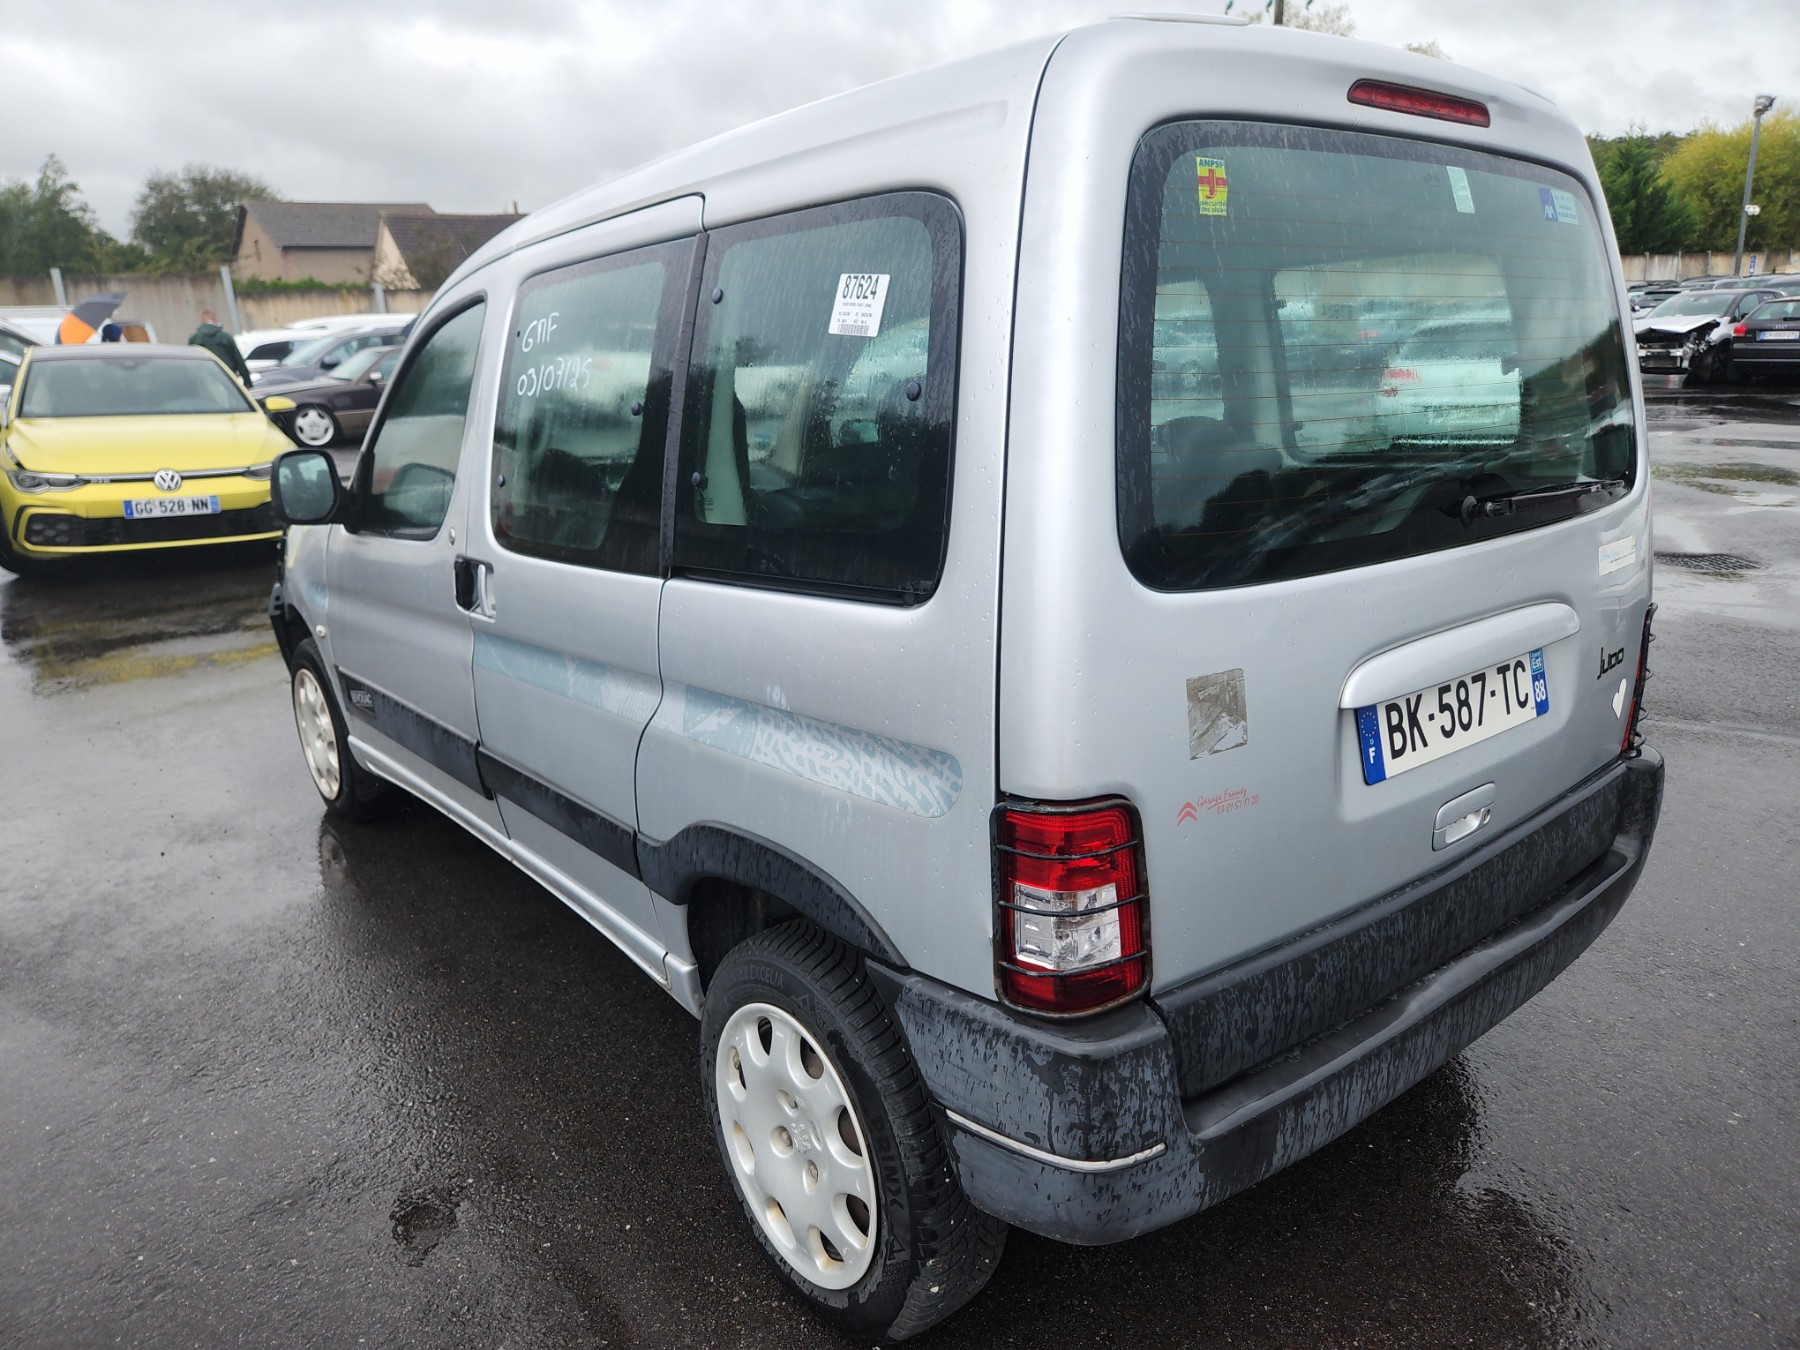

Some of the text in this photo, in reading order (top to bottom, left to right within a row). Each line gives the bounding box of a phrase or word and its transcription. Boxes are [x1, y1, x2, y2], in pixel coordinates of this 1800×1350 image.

[1199, 159, 1224, 168] ANPSP
[842, 274, 880, 300] 87624
[517, 356, 593, 398] 03/07/25
[1534, 679, 1546, 702] 88
[1385, 660, 1529, 760] BK-587-TC
[1368, 746, 1377, 764] F
[1197, 795, 1222, 808] Garage
